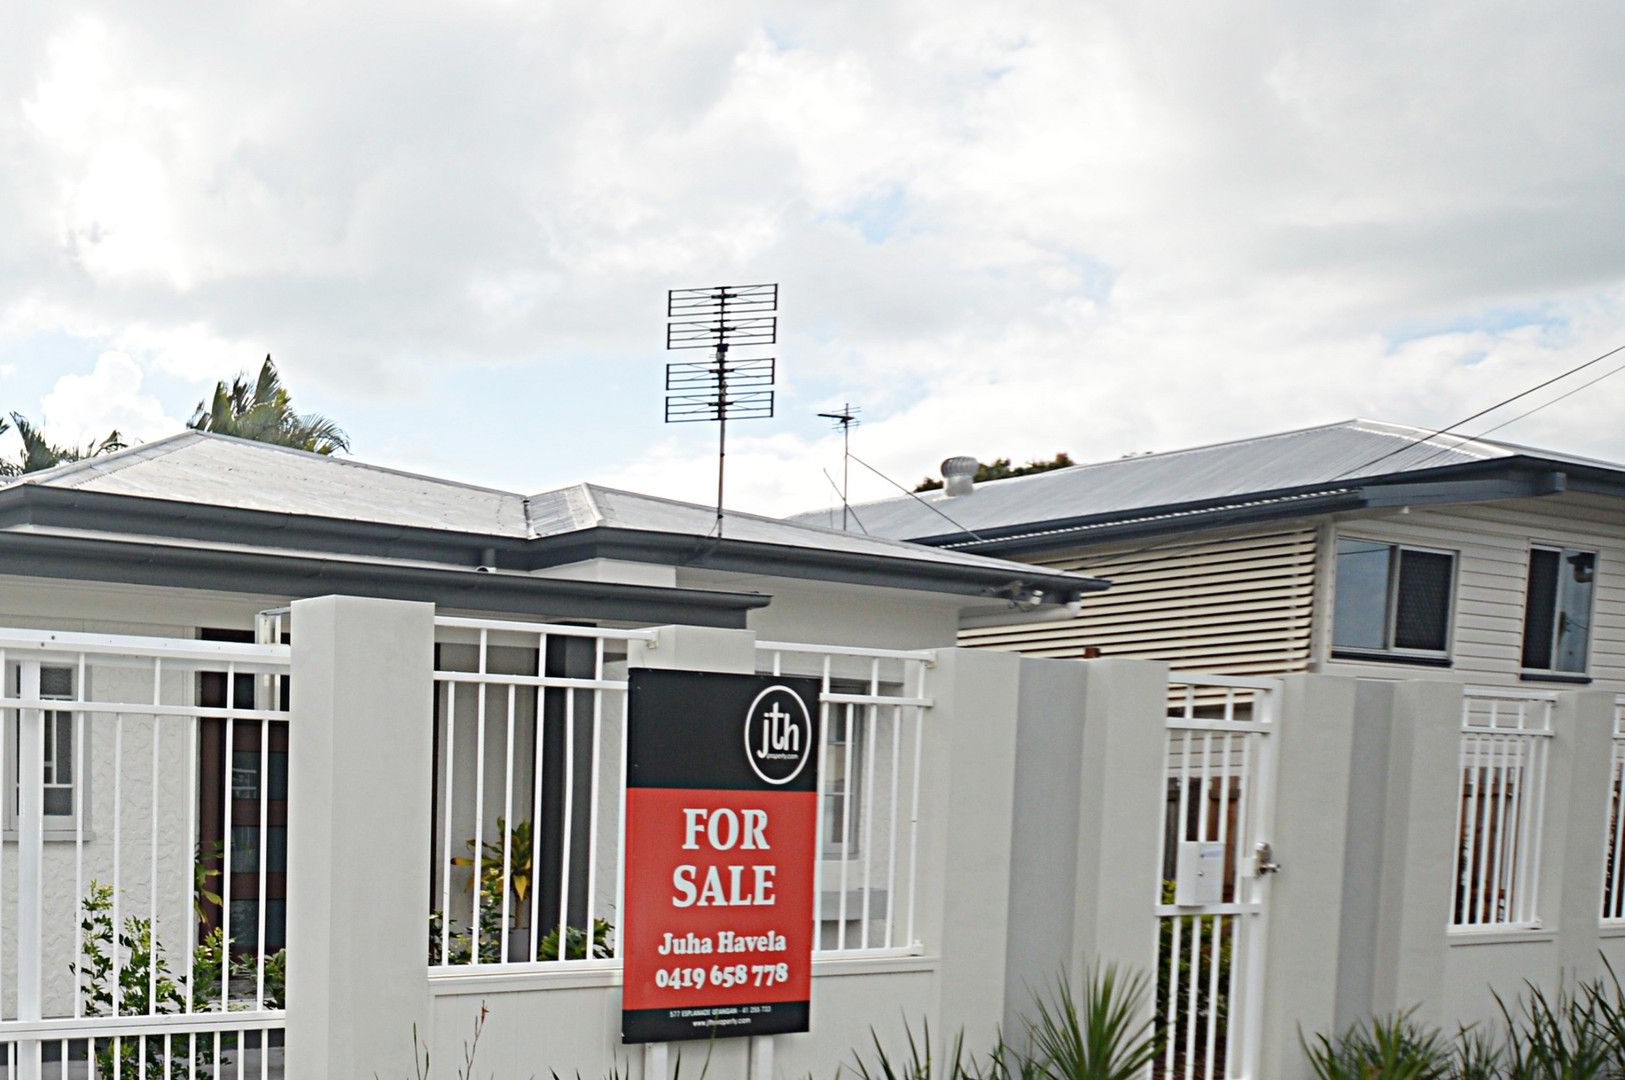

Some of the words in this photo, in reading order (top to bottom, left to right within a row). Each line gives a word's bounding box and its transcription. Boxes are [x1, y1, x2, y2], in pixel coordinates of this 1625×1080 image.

[757, 702, 799, 759] jth
[681, 807, 771, 851] FOR
[672, 864, 776, 908] SALE
[657, 932, 713, 955] Juha
[717, 930, 787, 953] Havela
[655, 967, 706, 990] 0419
[710, 964, 748, 988] 658
[751, 962, 788, 987] 778
